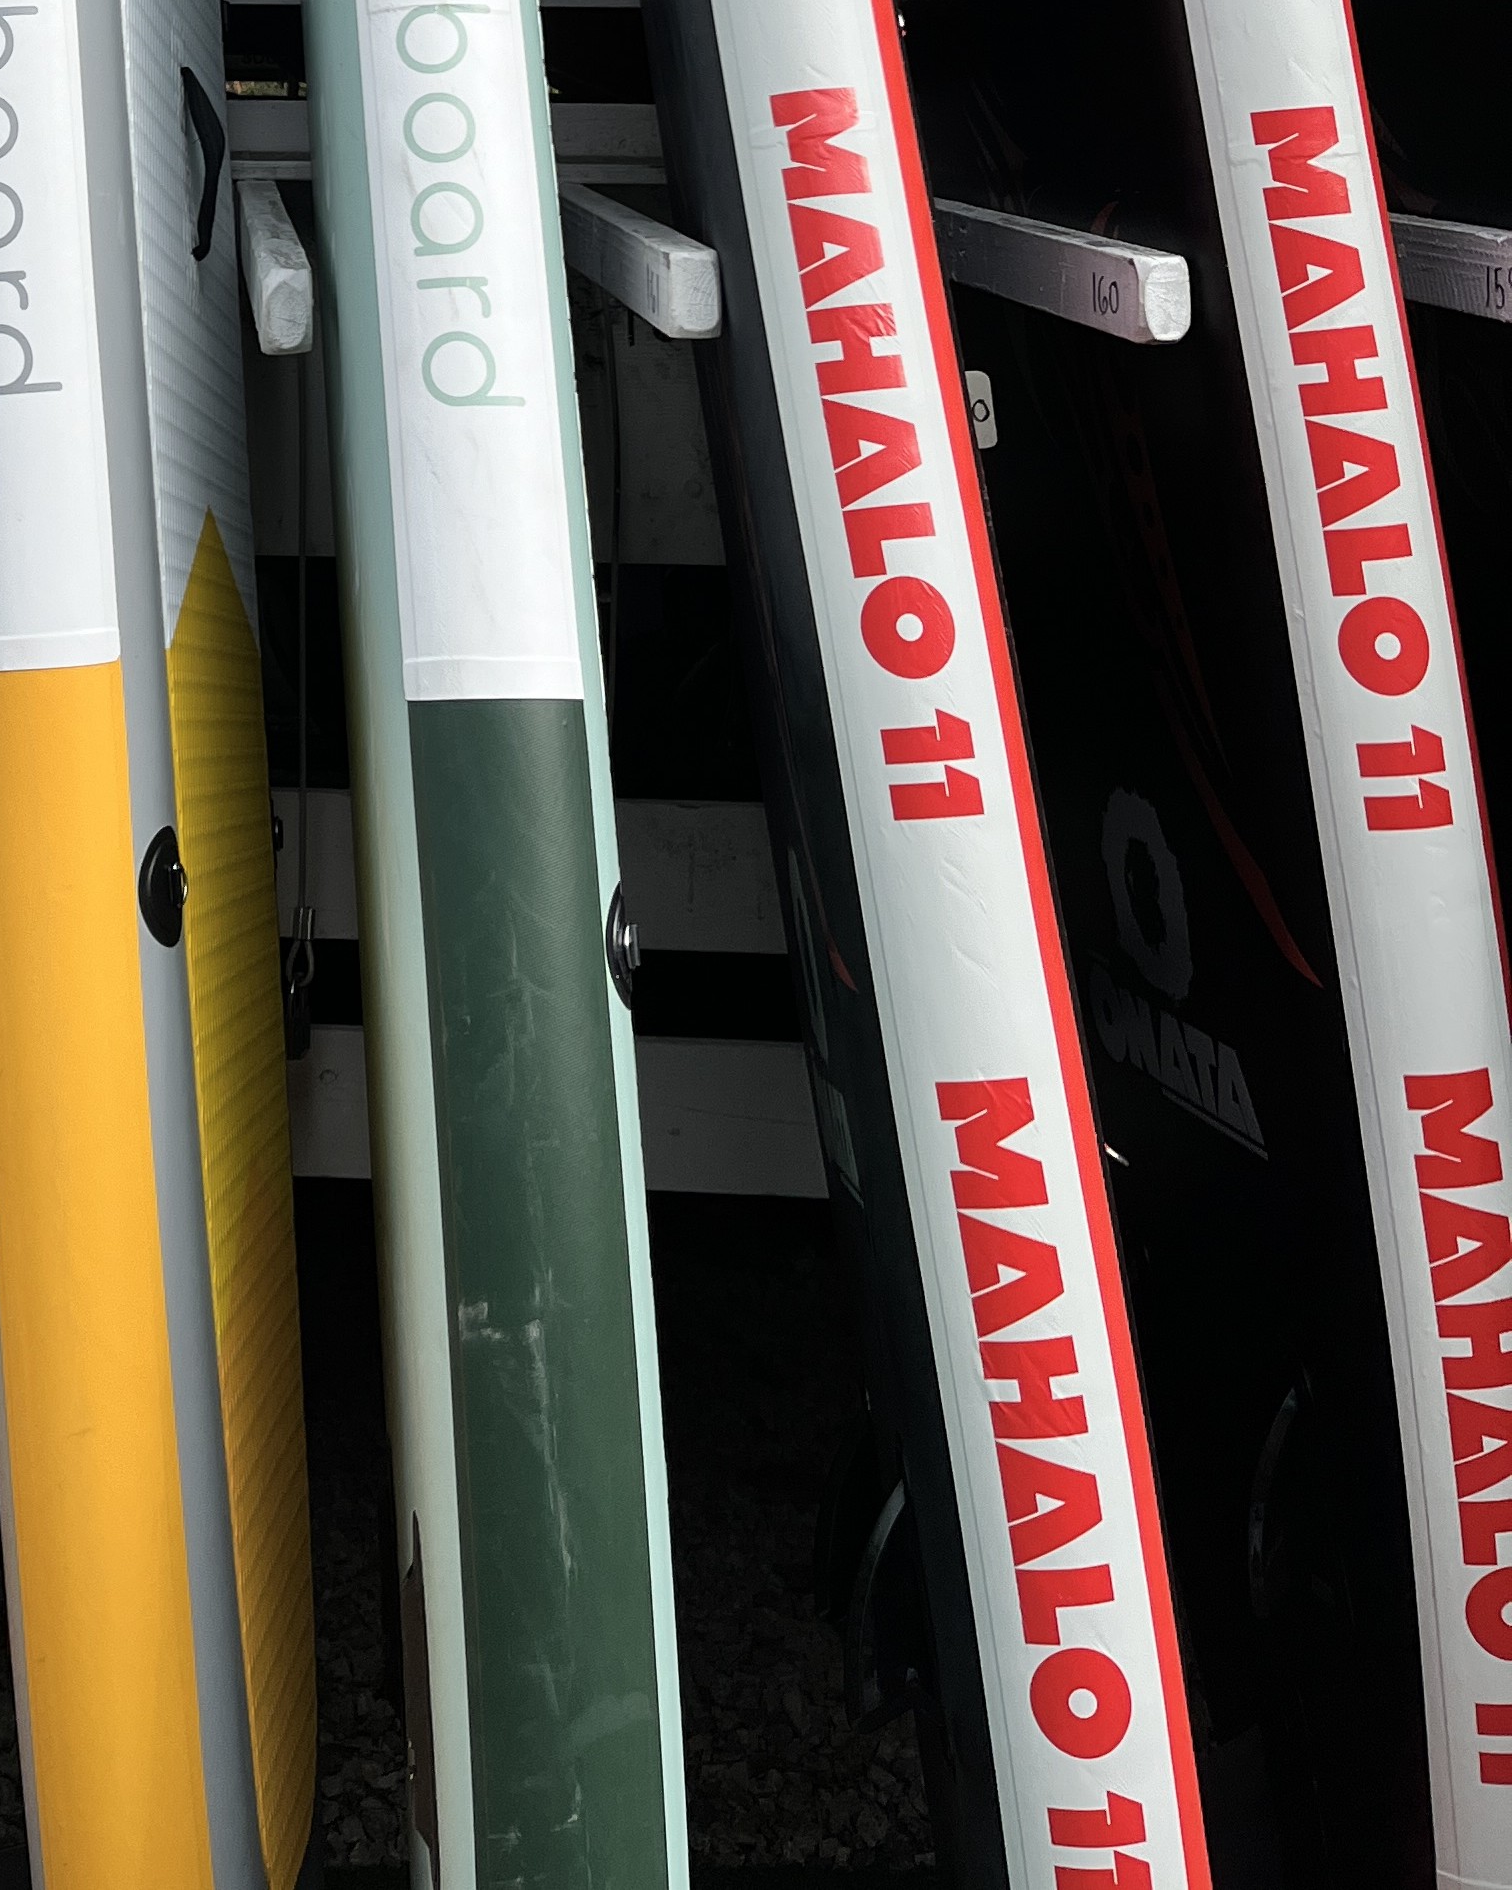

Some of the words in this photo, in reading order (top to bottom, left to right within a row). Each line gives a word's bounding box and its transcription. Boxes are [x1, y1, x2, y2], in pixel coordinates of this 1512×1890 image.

[395, 3, 526, 407] board
[769, 86, 956, 680] MAHALO
[880, 708, 985, 822] 11
[1091, 271, 1120, 316] 160
[1249, 105, 1430, 697] MAHALO
[1355, 725, 1454, 832] 11
[1485, 264, 1512, 310] 15
[935, 1076, 1133, 1761] MAHALO
[1047, 1790, 1155, 1890] 11
